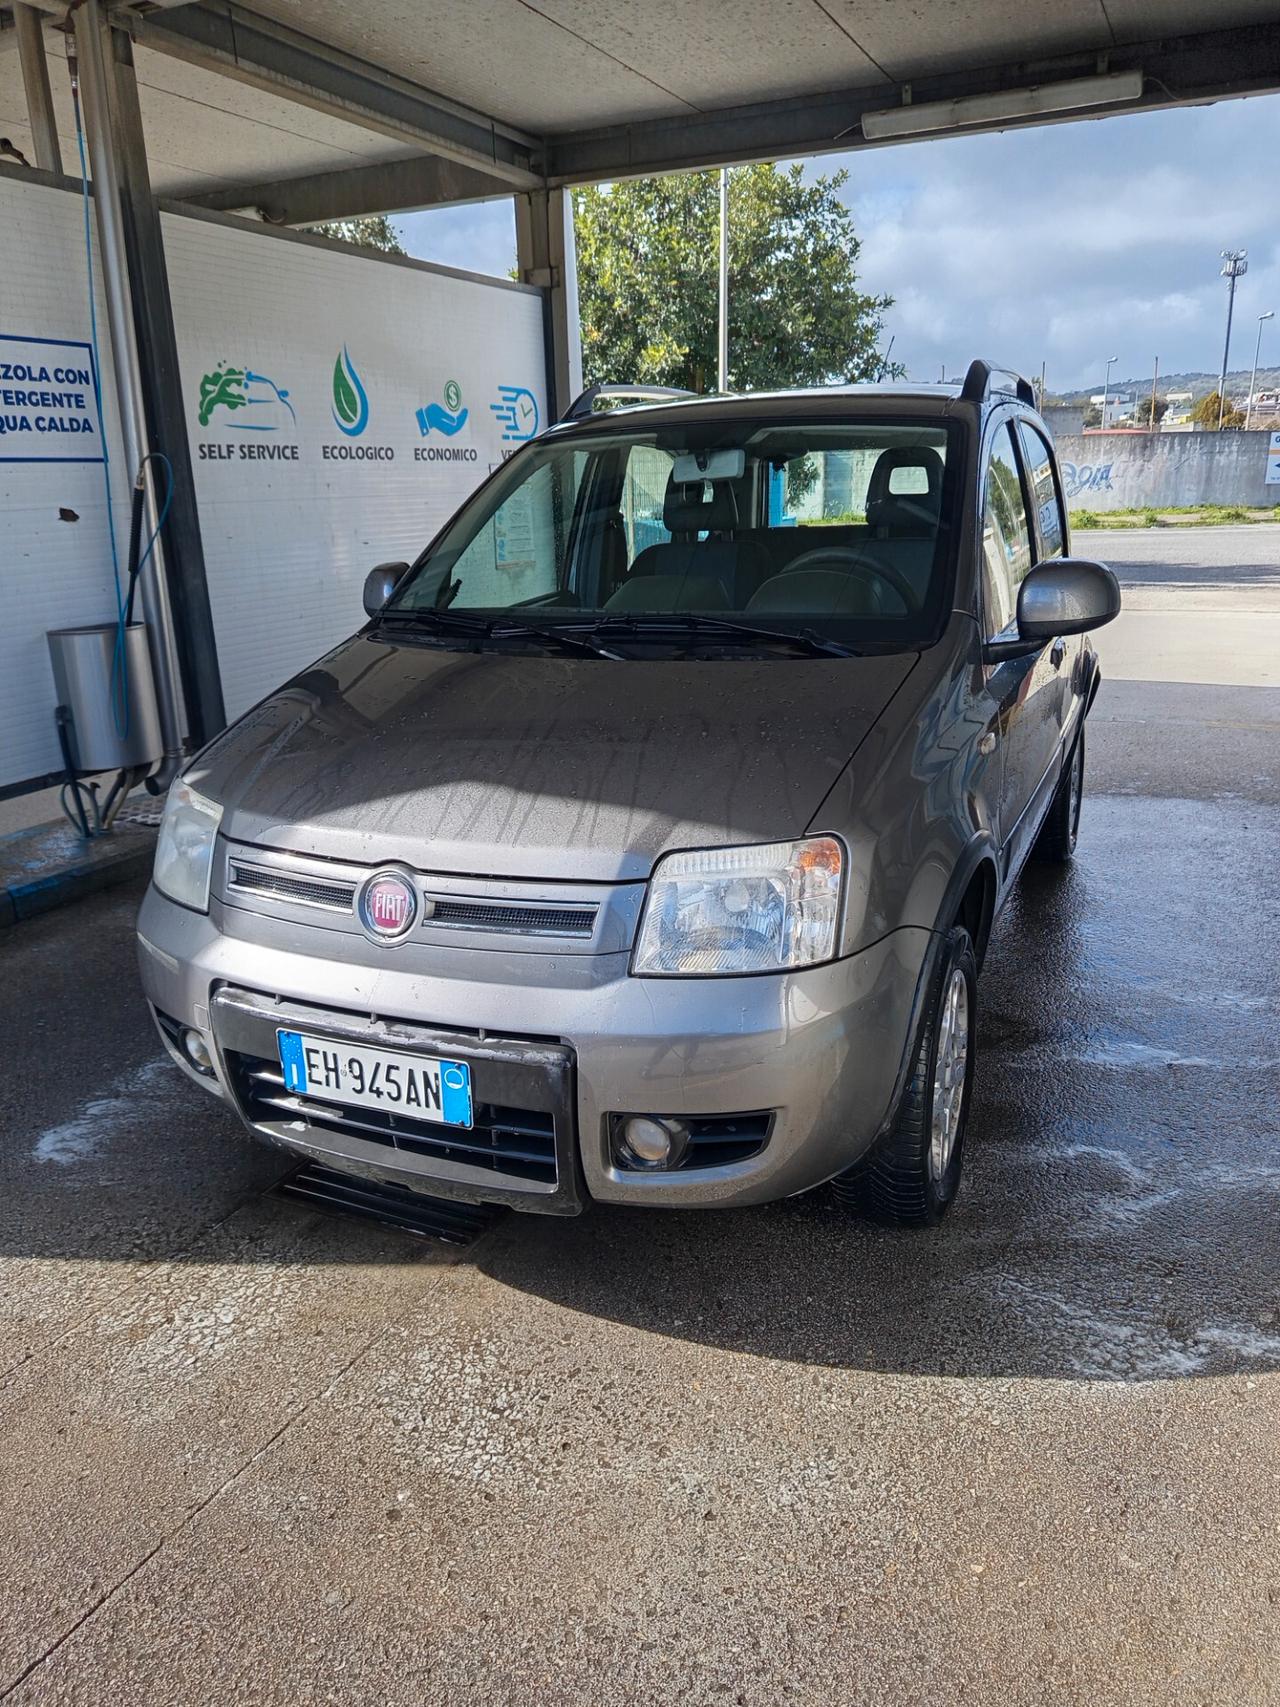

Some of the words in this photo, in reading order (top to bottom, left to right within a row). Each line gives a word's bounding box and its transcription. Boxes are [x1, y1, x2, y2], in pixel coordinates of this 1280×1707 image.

[0, 363, 51, 382] ZOLA
[54, 367, 90, 385] CON
[0, 389, 86, 409] ERGENTE
[35, 415, 94, 433] CALDA
[199, 444, 235, 460] SELF
[239, 444, 299, 460] SERVICE
[322, 445, 395, 461] ECOLOGICO
[414, 447, 478, 462] ECONOMICO
[374, 893, 404, 921] FIAT
